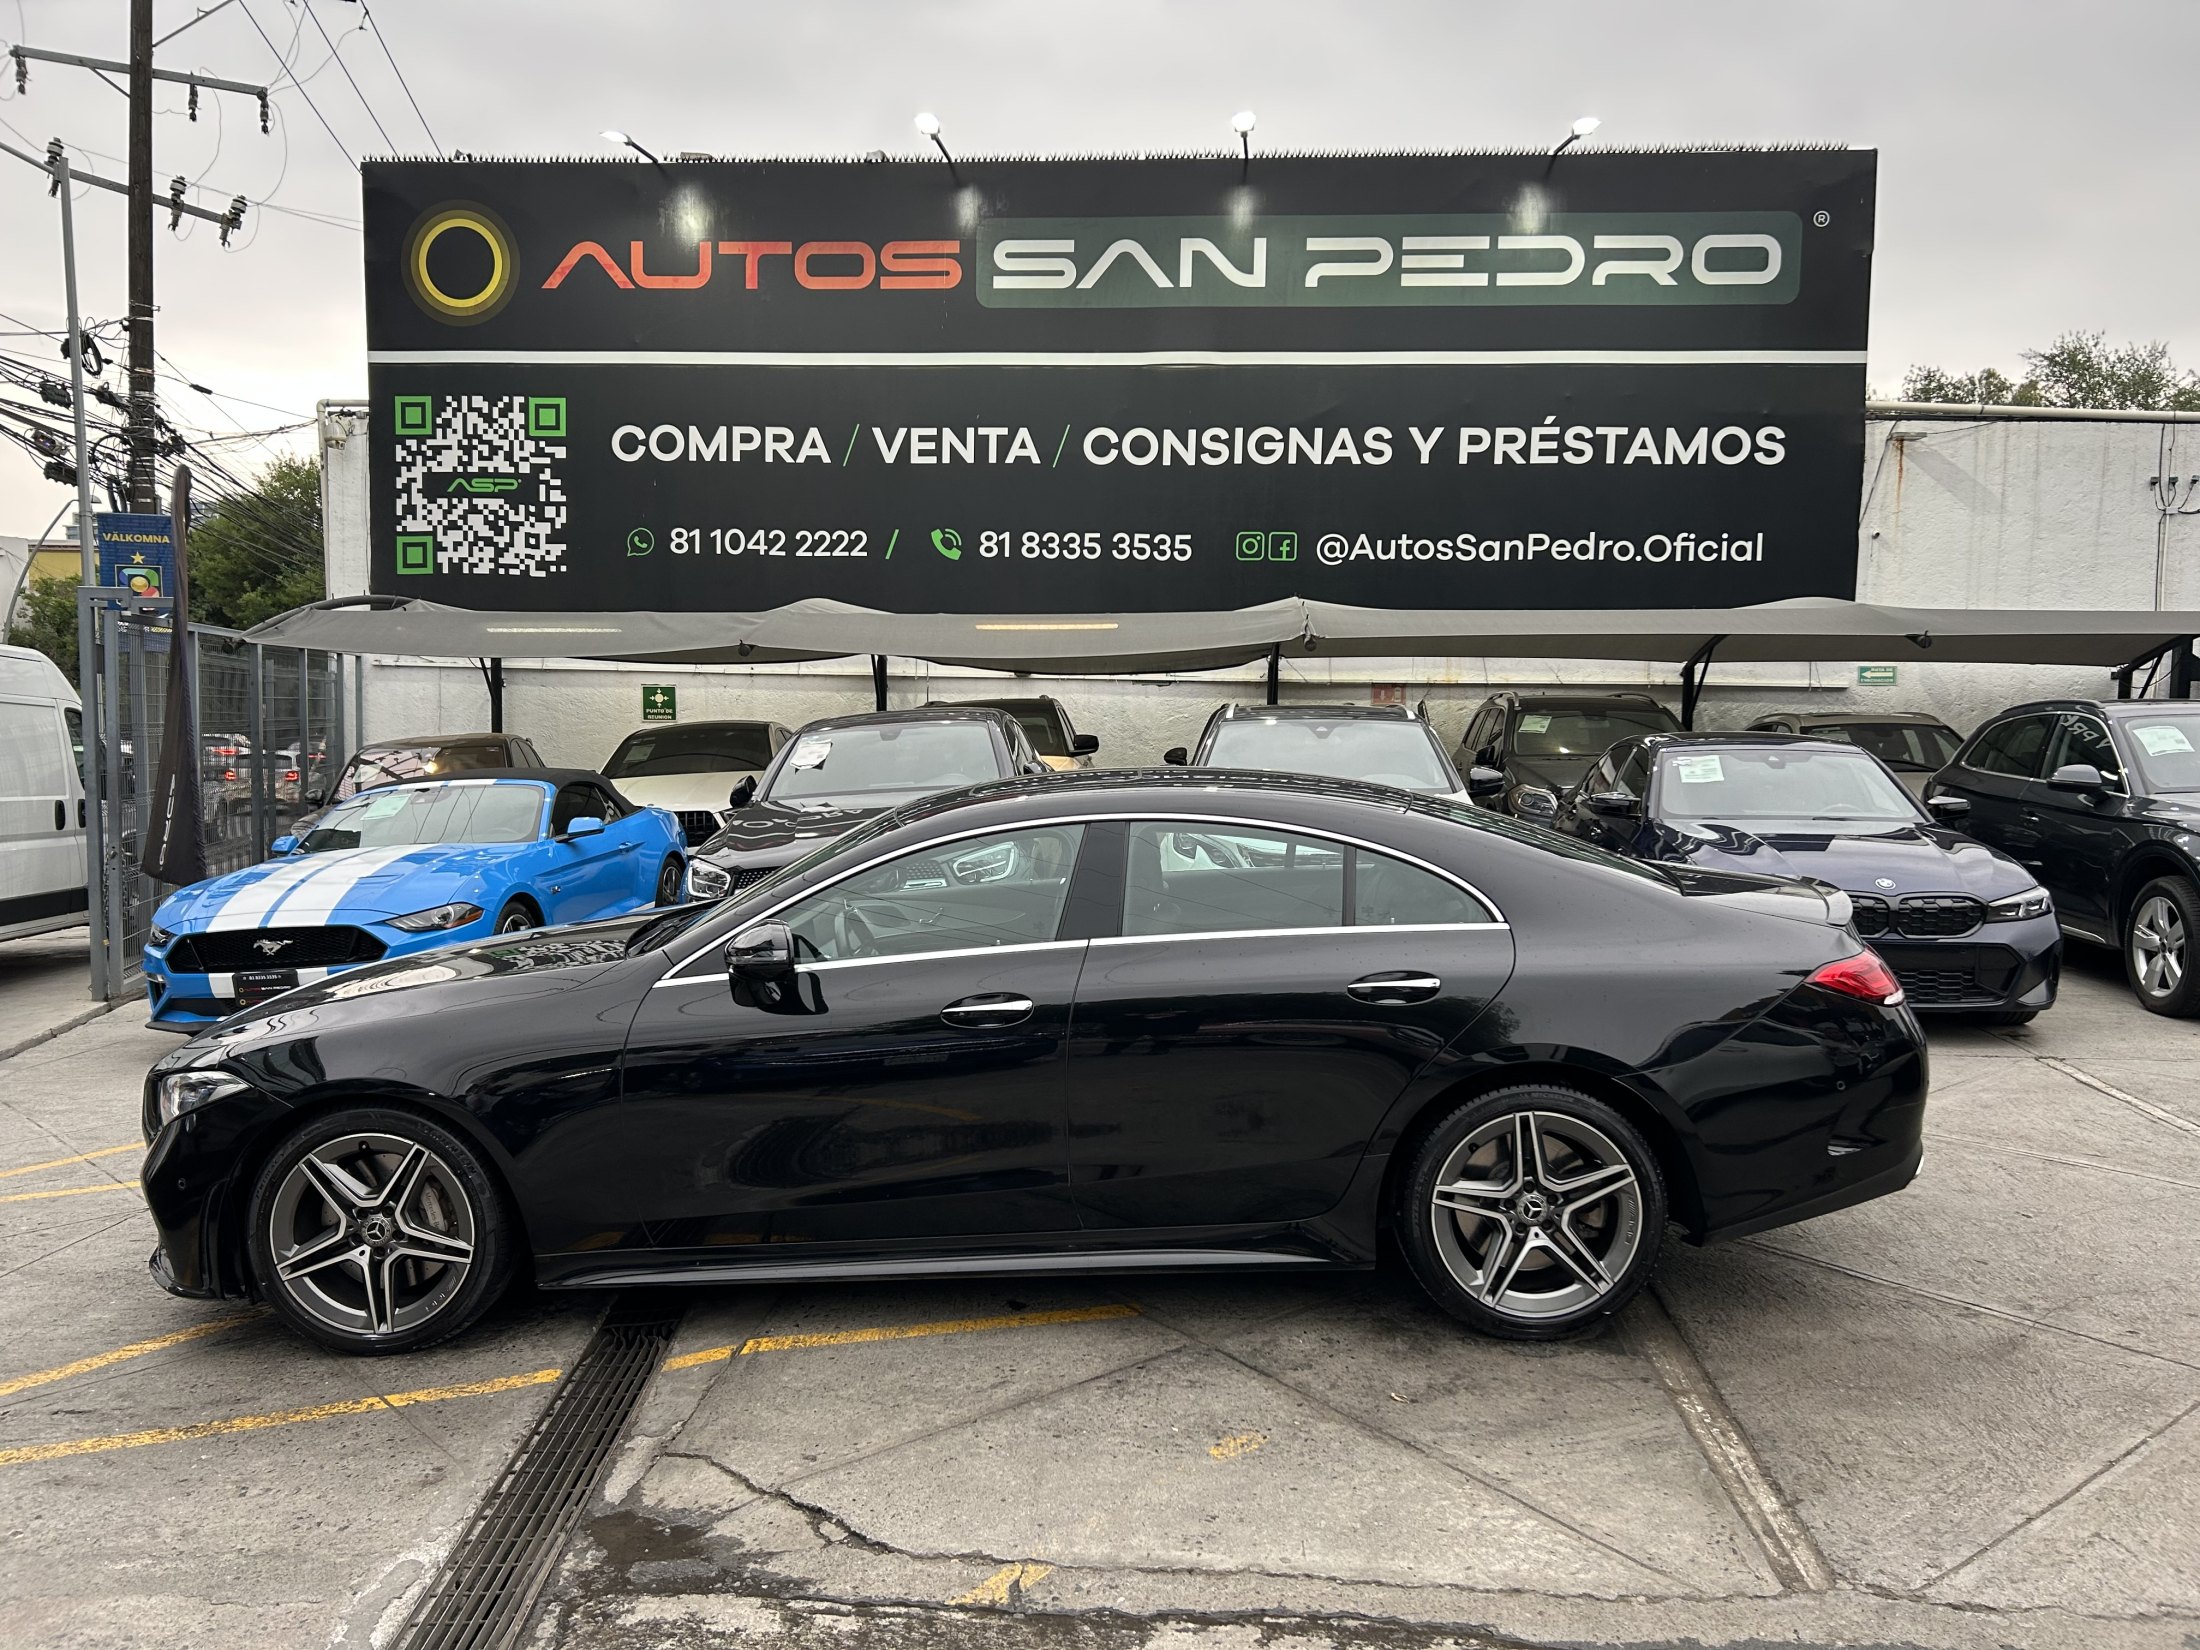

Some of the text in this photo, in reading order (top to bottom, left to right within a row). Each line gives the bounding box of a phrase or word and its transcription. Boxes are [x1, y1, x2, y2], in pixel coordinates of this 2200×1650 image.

[541, 239, 962, 291] AUTOS
[992, 237, 1268, 290] SAN
[1304, 233, 1783, 288] PEDRO
[611, 424, 832, 464] COMPRA
[871, 426, 1042, 465] VENTA
[1082, 426, 1393, 466] CONSIGNAS
[1408, 426, 1445, 465] Y
[1458, 415, 1786, 466] PRÉSTAMOS
[102, 532, 170, 543] VÄLKOMNA
[669, 527, 701, 555] 81
[709, 528, 787, 557] 1042
[795, 529, 868, 557] 2222
[979, 530, 1193, 562] 81 8335 3535
[1316, 531, 1764, 566] @AutosSanPedro.Oficial
